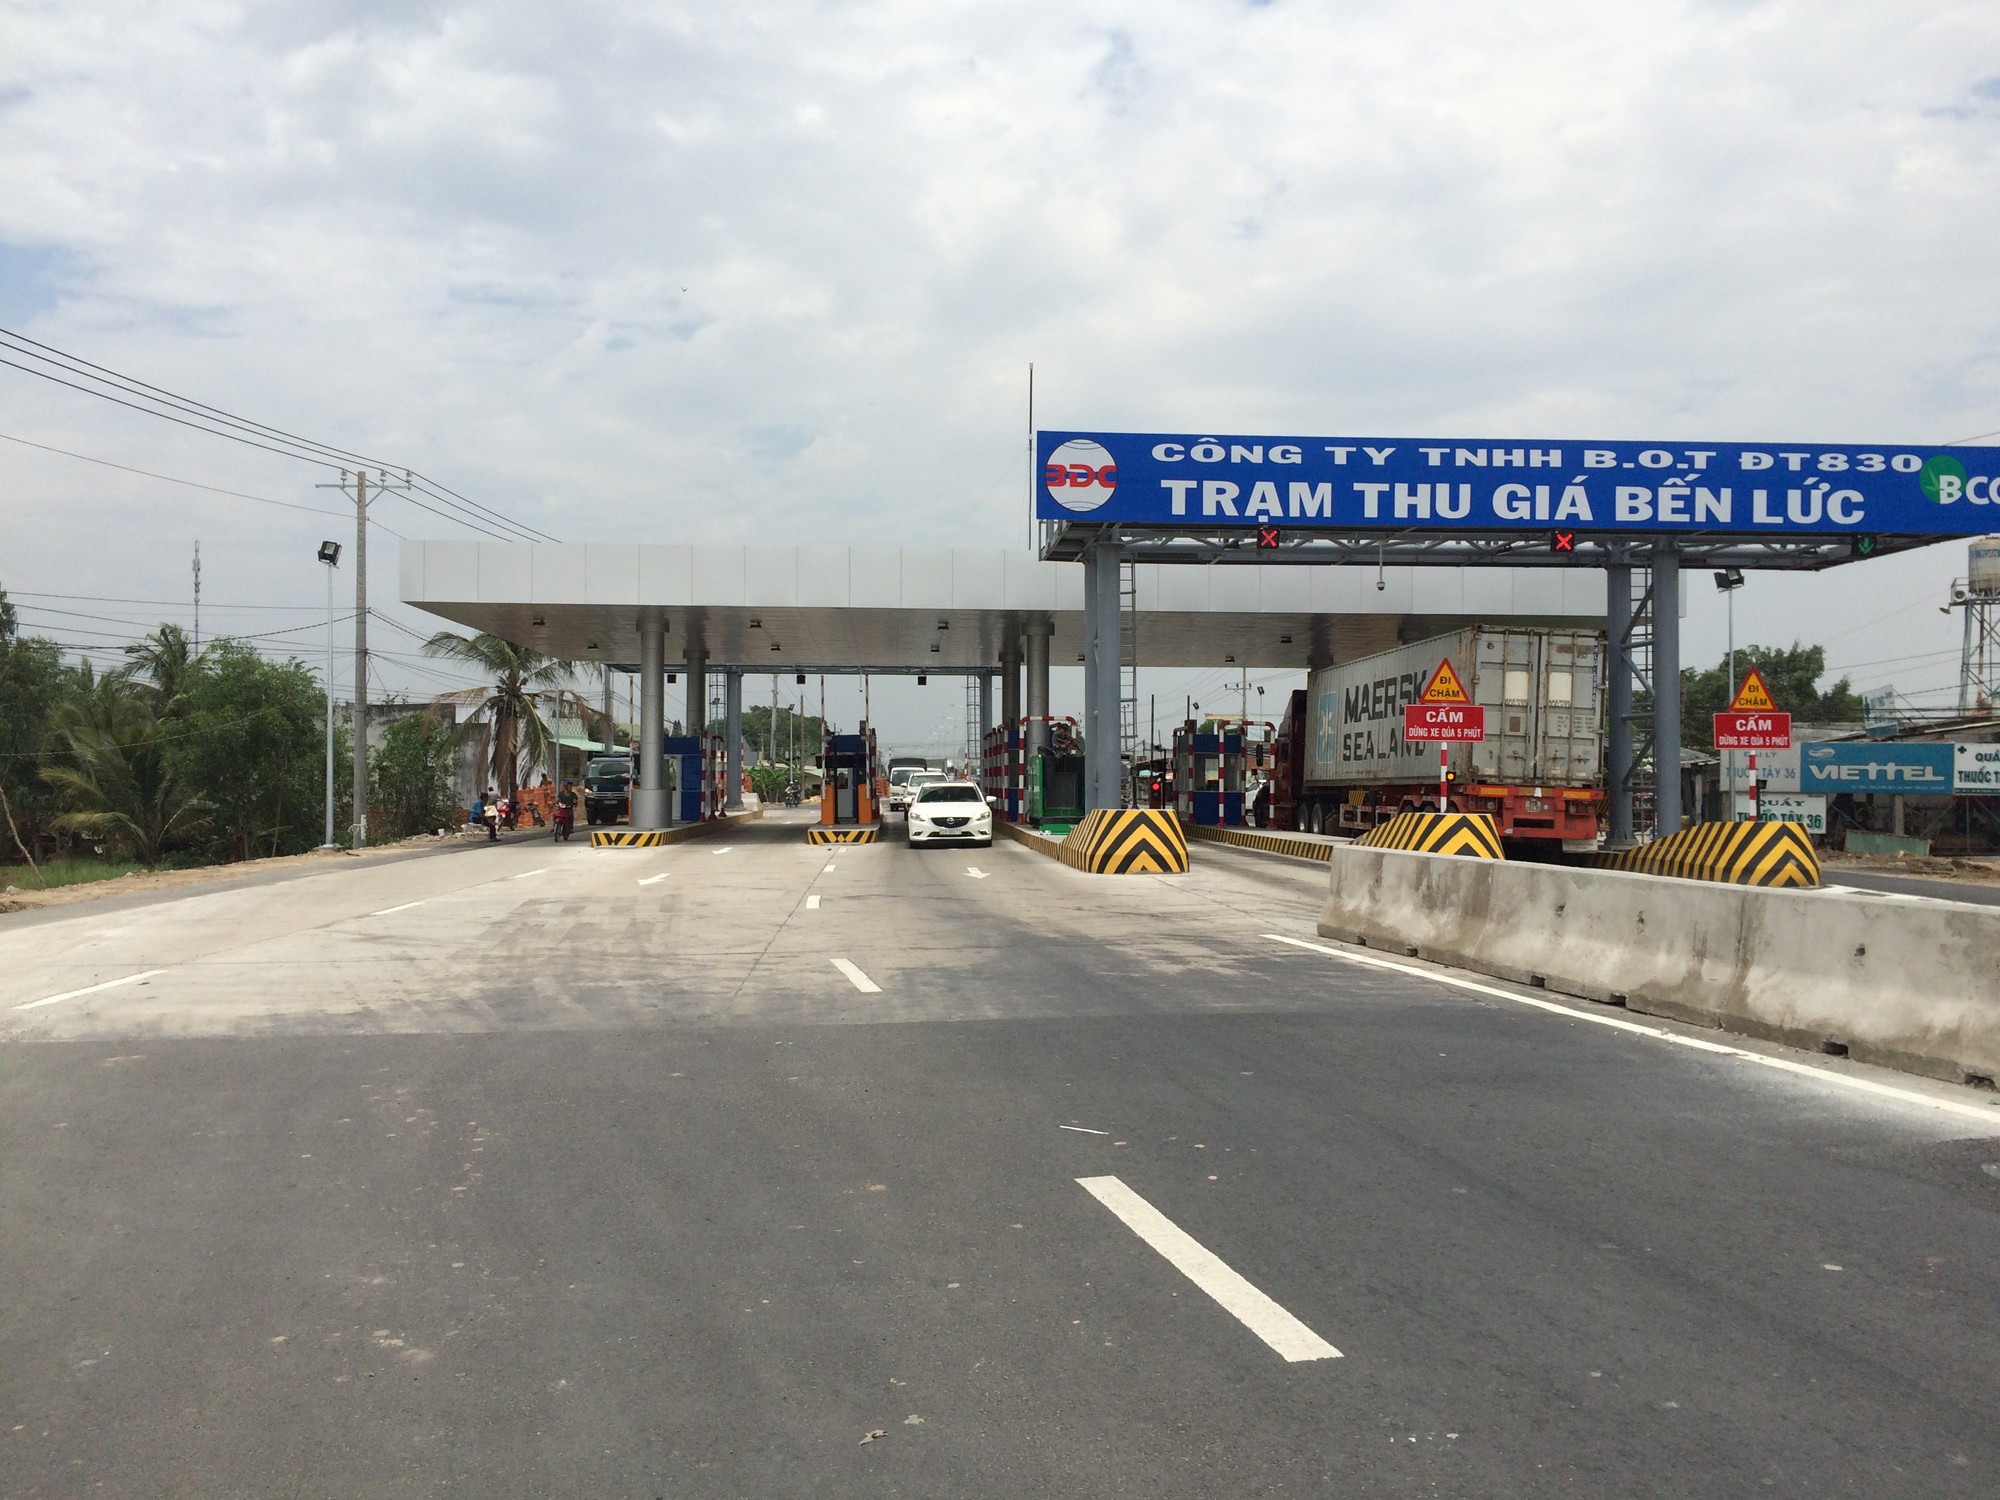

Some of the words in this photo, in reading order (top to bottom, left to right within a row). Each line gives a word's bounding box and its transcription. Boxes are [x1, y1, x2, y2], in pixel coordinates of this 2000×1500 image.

[1151, 437, 1302, 464] CÔNG
[1324, 446, 1397, 465] TY
[1418, 447, 1562, 468] TNHH
[1583, 449, 1717, 469] B.O.T
[1738, 451, 1923, 473] ĐT830
[1160, 479, 1333, 522] TRẠM
[1353, 481, 1471, 519] THU
[1492, 475, 1594, 521] GIÁ
[1615, 473, 1733, 522] BẾN
[1753, 477, 1865, 525] LỨC
[1439, 676, 1451, 684] ĐI
[1429, 688, 1460, 699] CHẬM
[1748, 684, 1760, 693] ĐI
[1343, 670, 1427, 724] MAERSK
[1738, 696, 1768, 707] CHẬM
[1425, 707, 1464, 723] CẤM
[1735, 715, 1773, 731] CẤM
[1430, 727, 1440, 737] XE
[1457, 728, 1462, 738] 5
[1463, 726, 1482, 738] PHÚT
[1740, 736, 1750, 746] XE
[1765, 736, 1771, 746] 5
[1771, 734, 1789, 746] PHÚT
[1784, 768, 1796, 779] 36
[1957, 766, 1992, 784] THUỐC
[1806, 814, 1823, 830] 36
